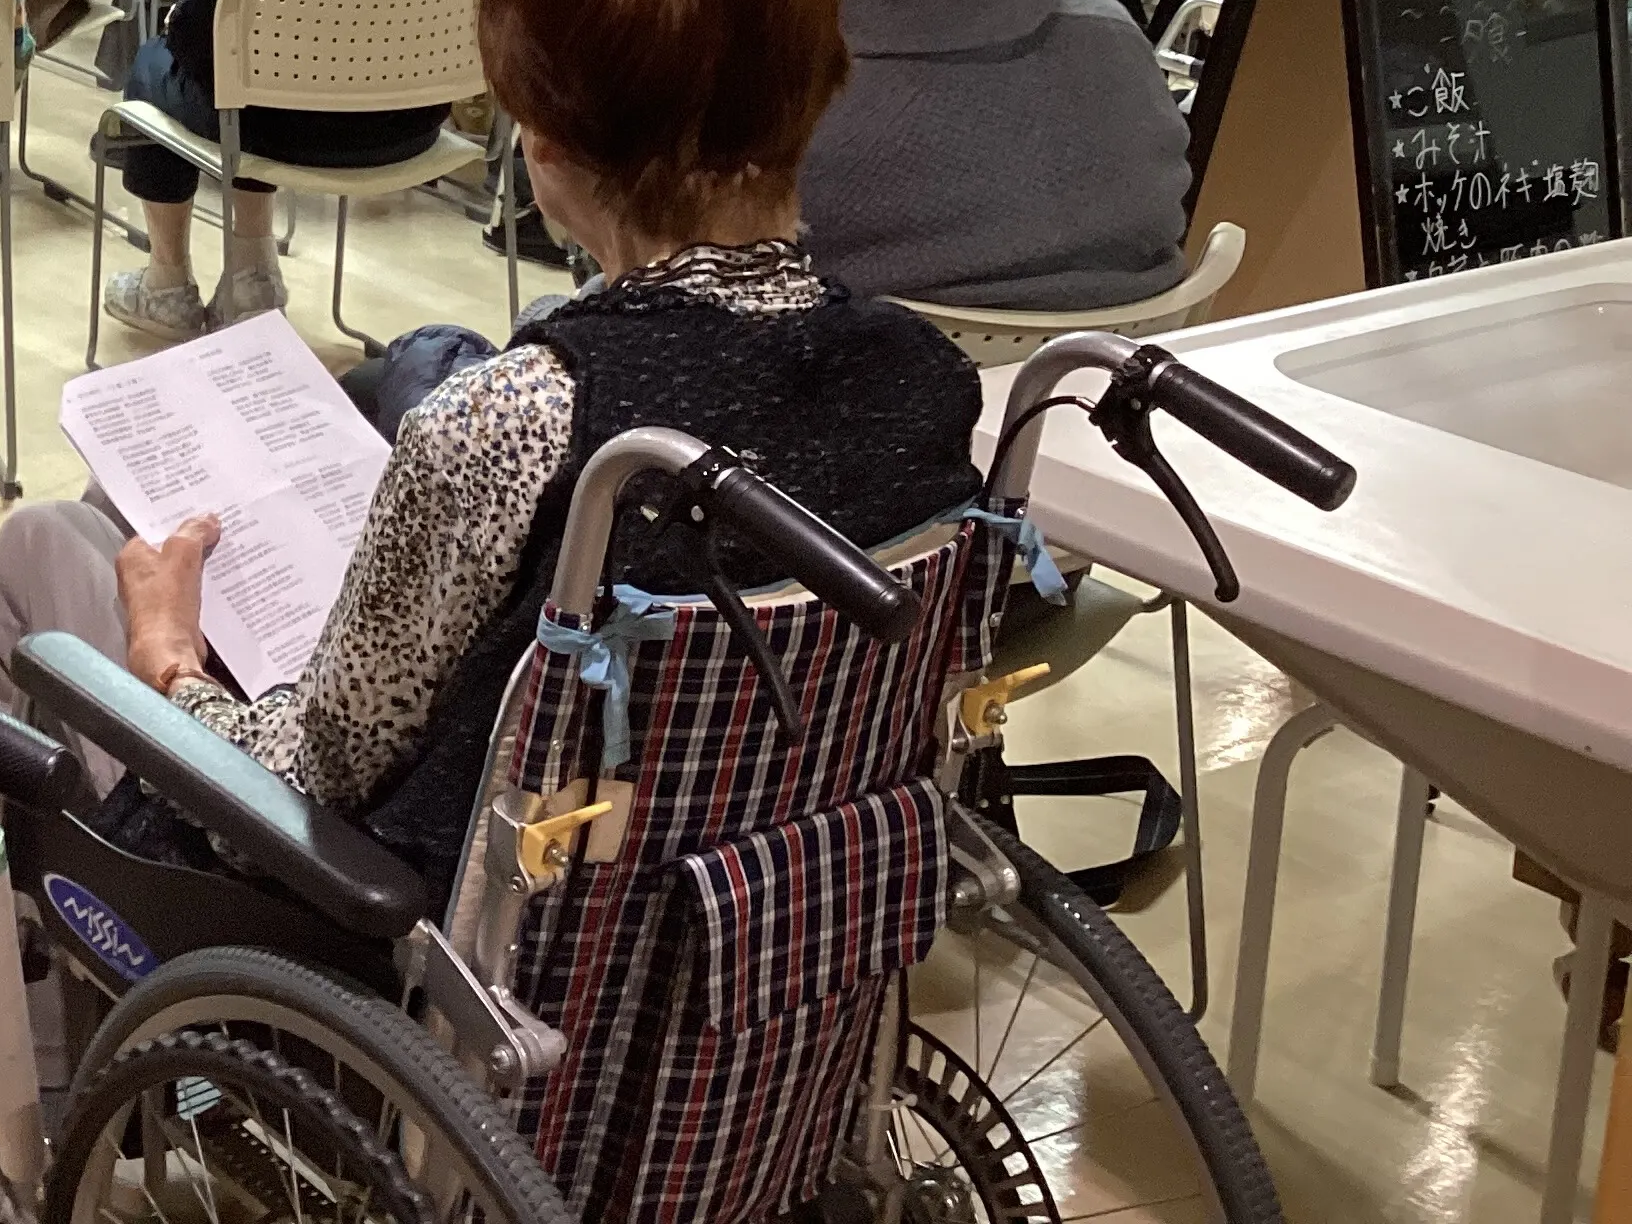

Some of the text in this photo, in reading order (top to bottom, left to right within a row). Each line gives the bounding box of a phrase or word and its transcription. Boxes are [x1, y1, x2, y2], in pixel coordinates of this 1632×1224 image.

[1407, 62, 1470, 117] ご飯
[1411, 120, 1491, 170] みそ汁
[1420, 212, 1478, 256] 焼き
